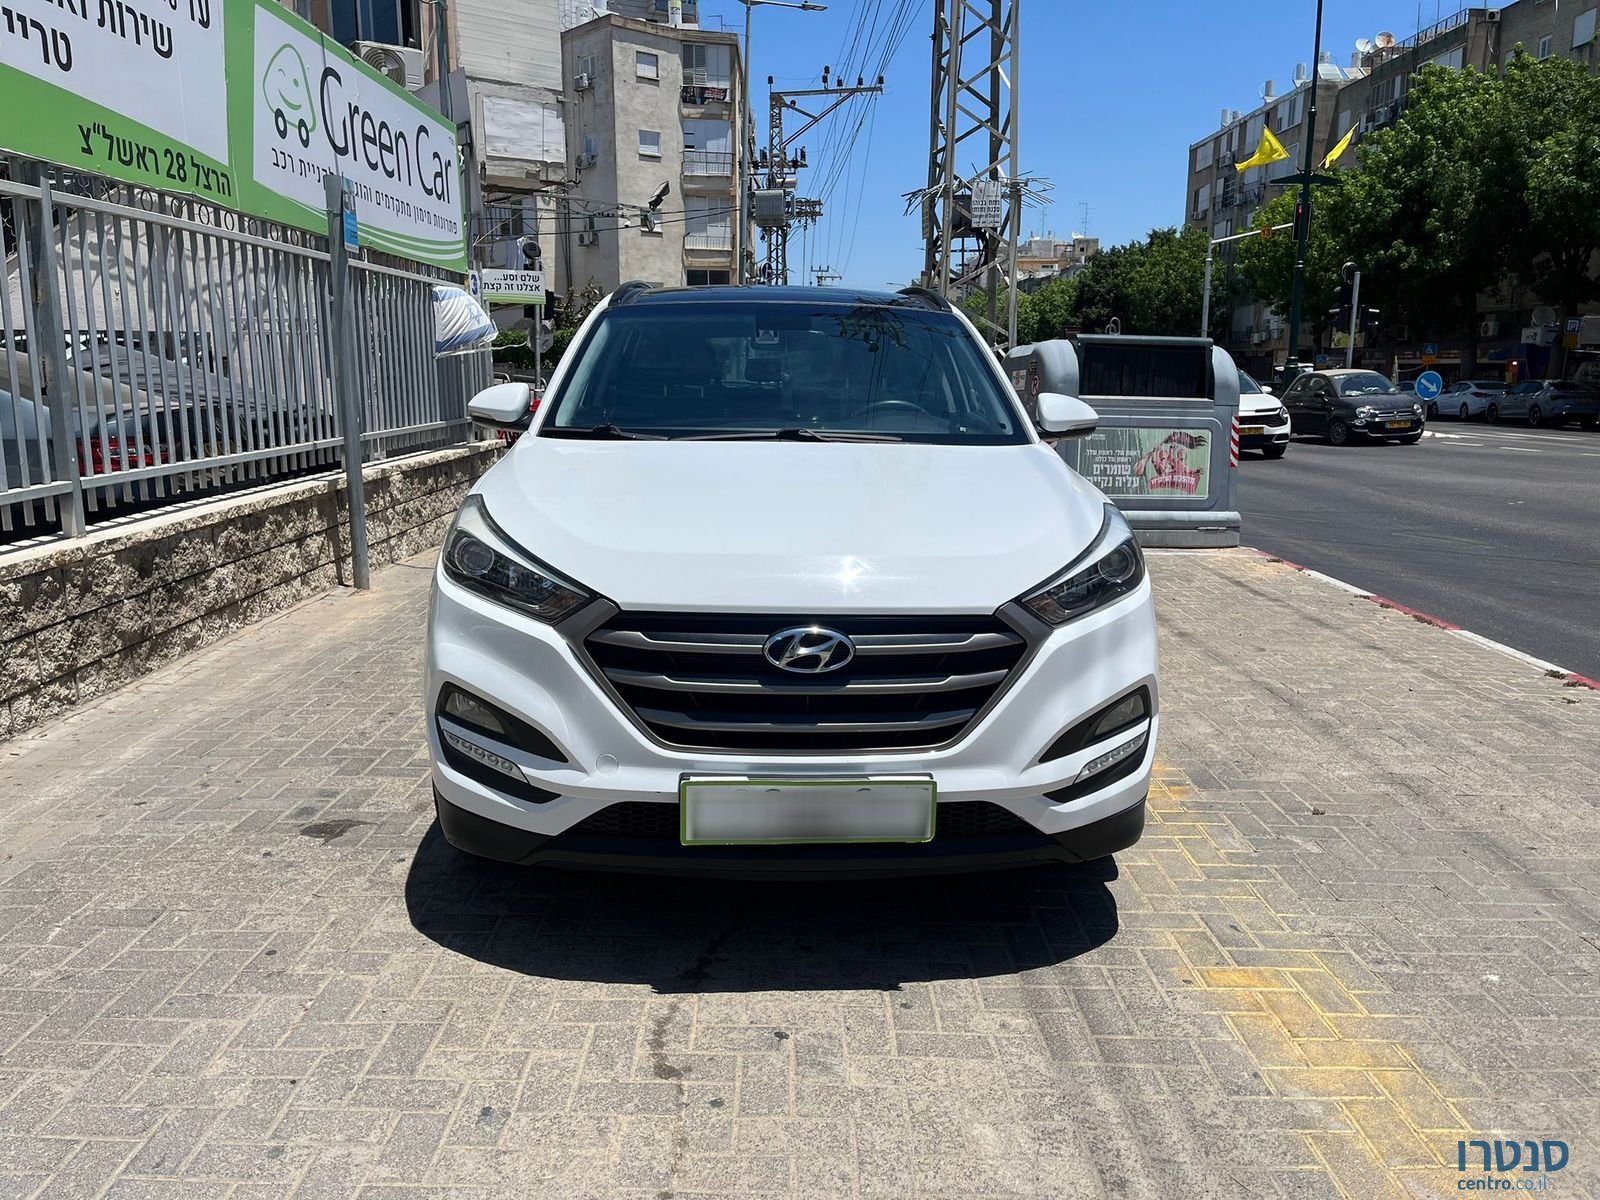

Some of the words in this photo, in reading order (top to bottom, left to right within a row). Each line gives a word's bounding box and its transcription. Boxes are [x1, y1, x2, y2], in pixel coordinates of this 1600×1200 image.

[97, 0, 173, 59] שירות
[319, 66, 412, 187] Green
[415, 124, 452, 204] Car
[164, 148, 187, 183] 28
[271, 147, 295, 173] רכב
[190, 155, 232, 197] הרצל
[375, 190, 412, 218] מתקדמים
[413, 205, 432, 226] מימון
[434, 213, 458, 235] פתרונות
[483, 282, 502, 292] קצת
[494, 273, 518, 282] וסע...
[504, 283, 514, 291] זה
[516, 282, 541, 292] אצלנו
[520, 273, 540, 283] שלם
[1093, 463, 1132, 475] שומרים
